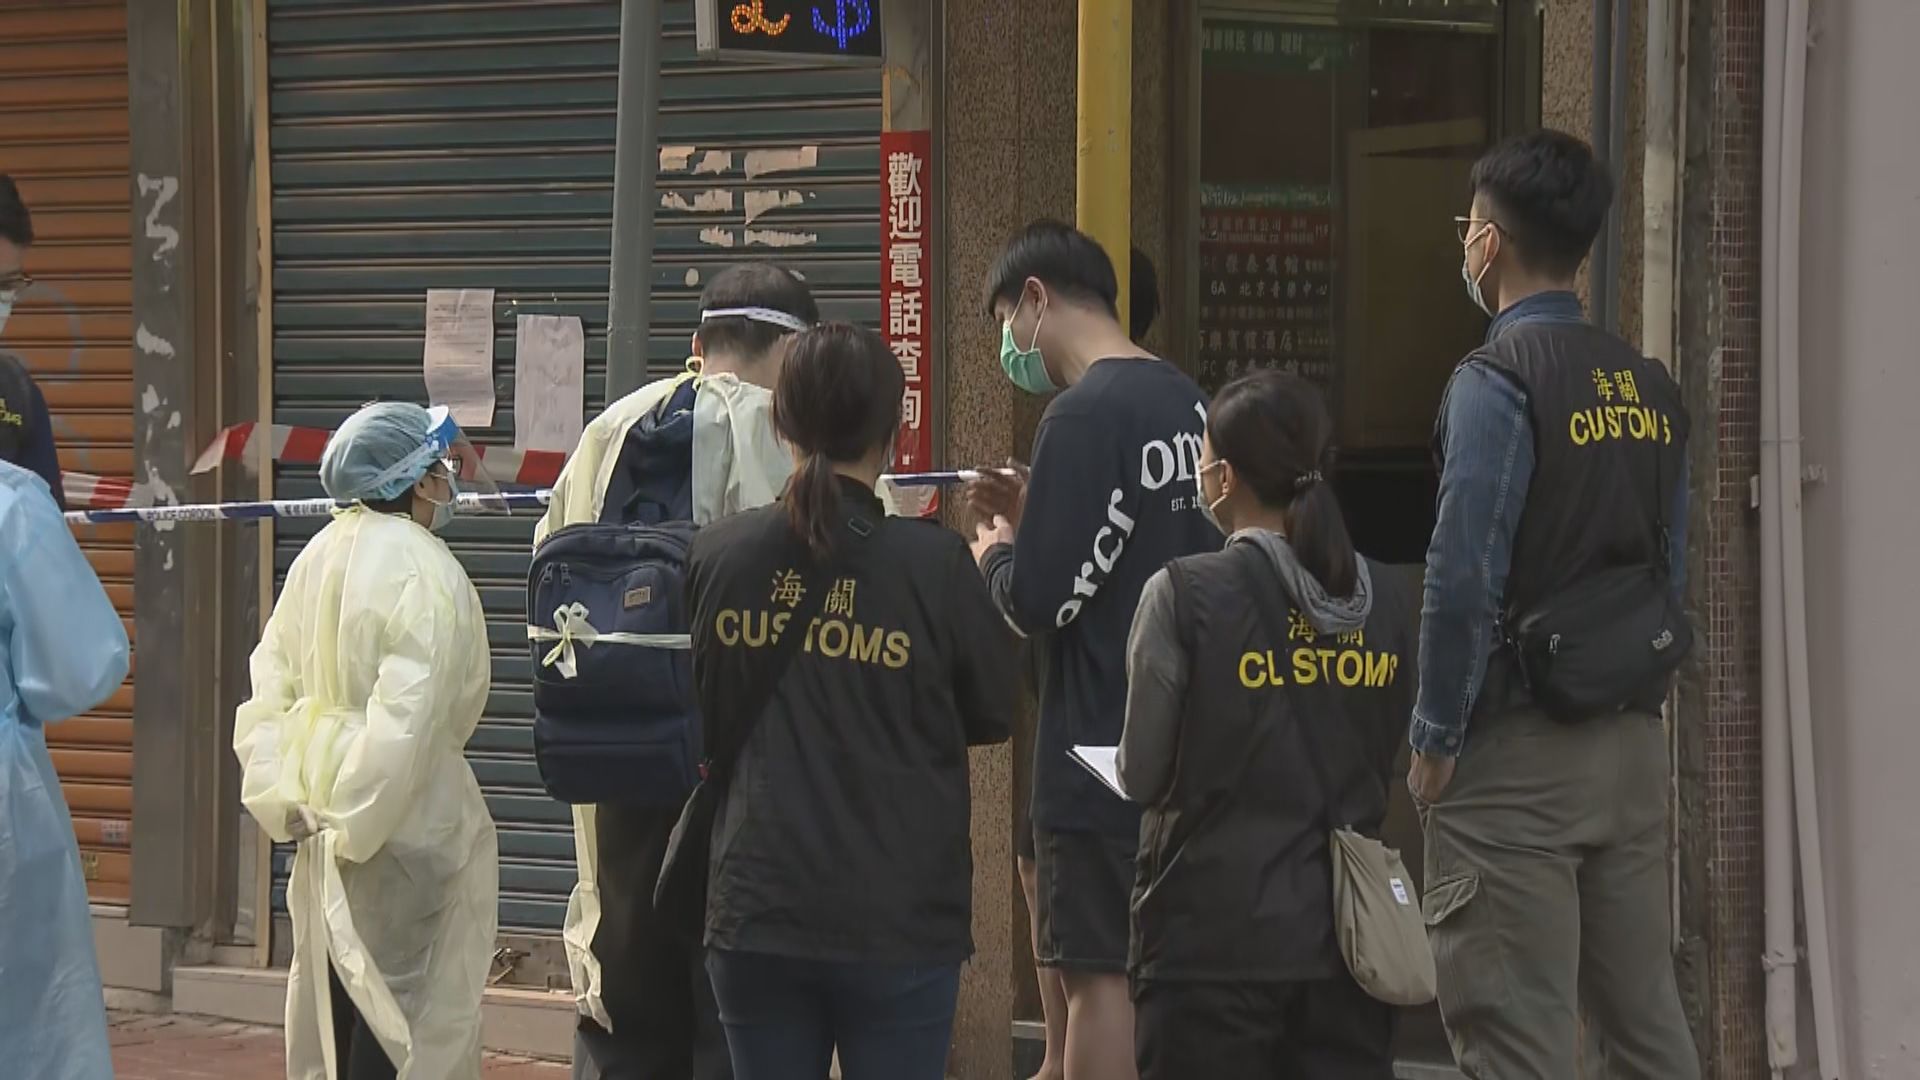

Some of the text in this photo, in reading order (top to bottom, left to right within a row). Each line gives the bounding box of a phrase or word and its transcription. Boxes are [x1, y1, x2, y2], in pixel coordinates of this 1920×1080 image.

[1210, 280, 1226, 296] 6A
[1592, 367, 1640, 404] 海關
[1171, 497, 1186, 511] EST.
[769, 567, 857, 619] 海關
